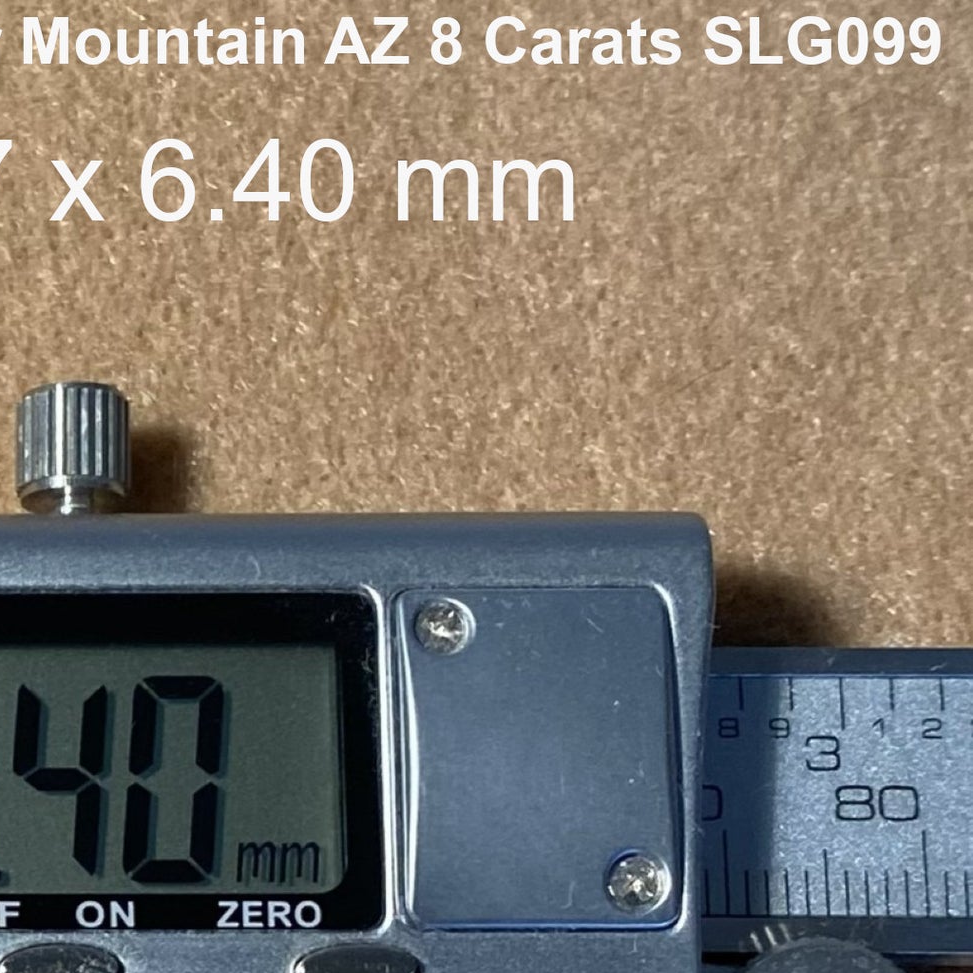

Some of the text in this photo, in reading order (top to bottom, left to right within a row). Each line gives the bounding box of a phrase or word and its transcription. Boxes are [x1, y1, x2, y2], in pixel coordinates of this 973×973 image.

[805, 735, 841, 771] 3
[835, 784, 920, 821] 80
[237, 838, 320, 885] mm
[74, 899, 135, 928] ON
[216, 899, 322, 928] ZERO
